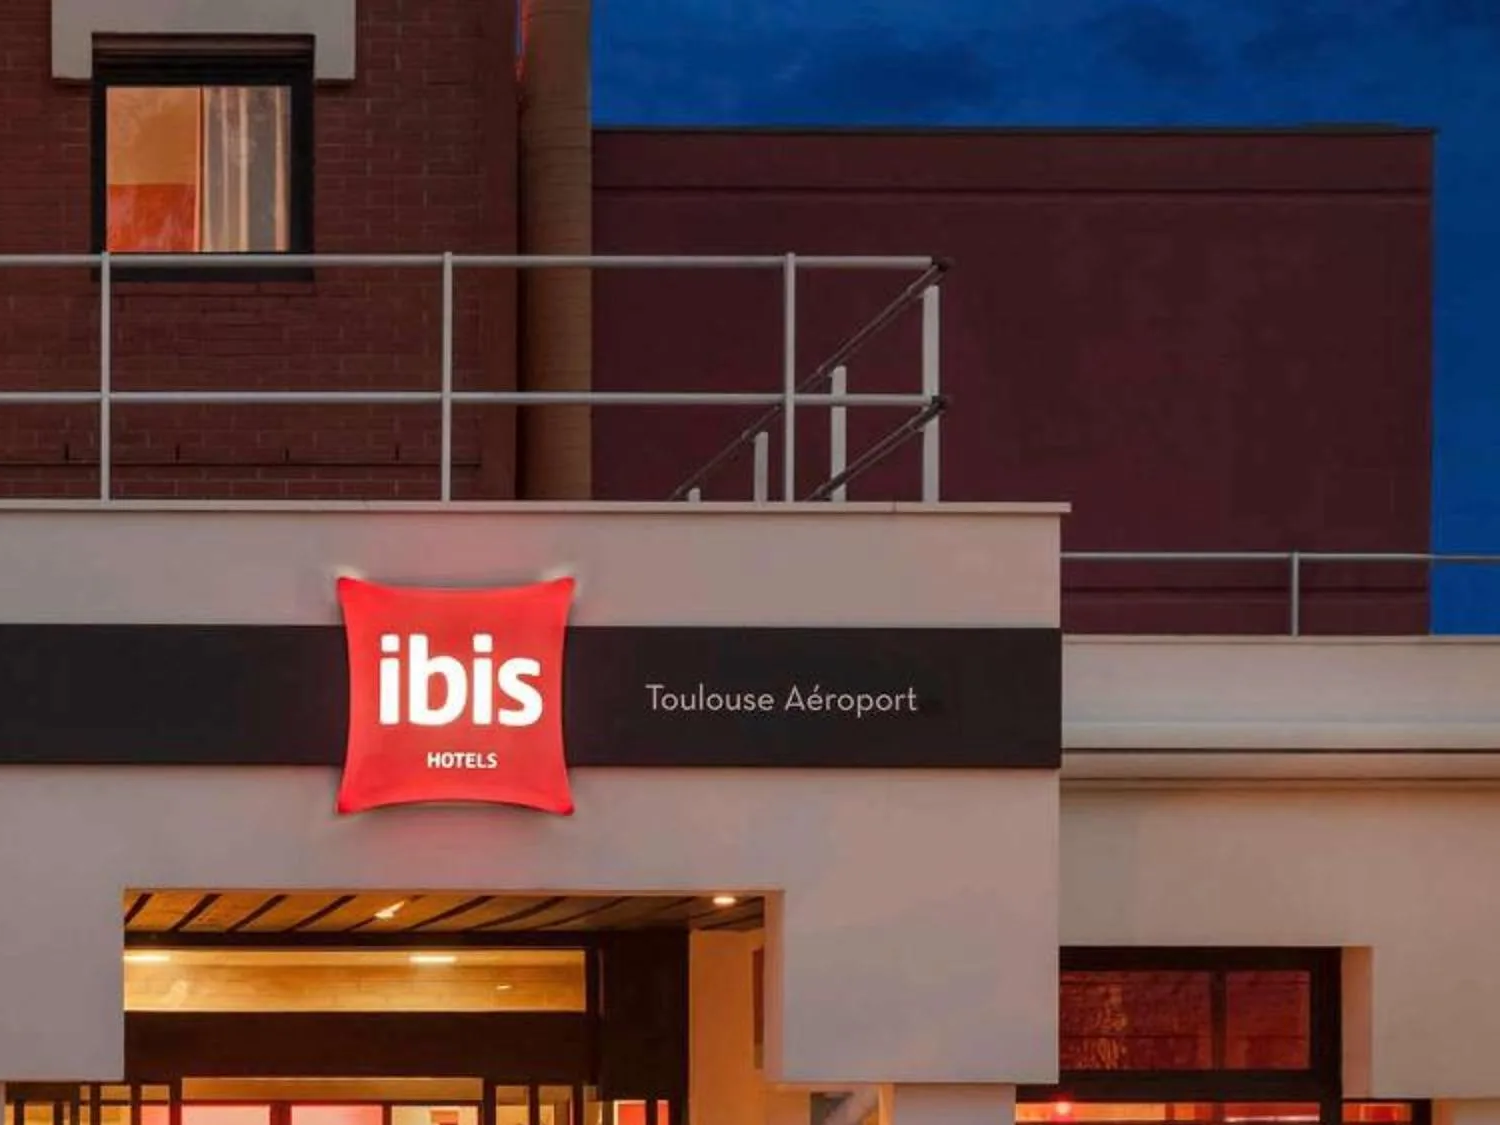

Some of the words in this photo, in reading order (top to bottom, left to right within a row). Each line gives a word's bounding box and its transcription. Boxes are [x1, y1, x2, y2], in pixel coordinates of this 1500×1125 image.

[379, 633, 543, 726] ibis
[645, 684, 774, 712] Toulouse
[785, 682, 918, 718] Aéroport
[427, 751, 498, 769] HOTELS
